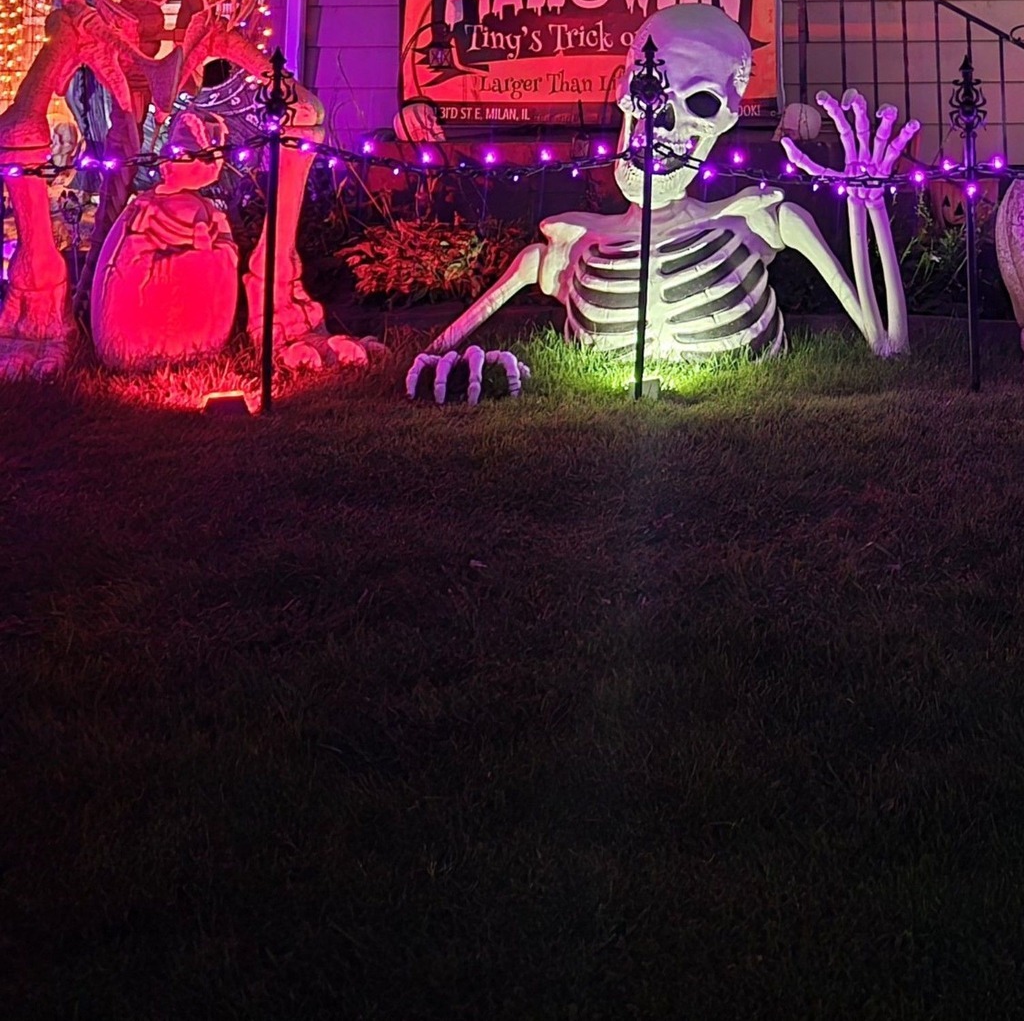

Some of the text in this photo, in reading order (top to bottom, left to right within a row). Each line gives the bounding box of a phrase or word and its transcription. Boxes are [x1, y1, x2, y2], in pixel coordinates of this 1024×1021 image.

[464, 20, 637, 60] Tiny's Trick o
[479, 75, 542, 100] Larger
[546, 70, 592, 95] Than
[460, 107, 472, 119] ST
[485, 108, 519, 122] MILAN,
[521, 108, 531, 120] IL
